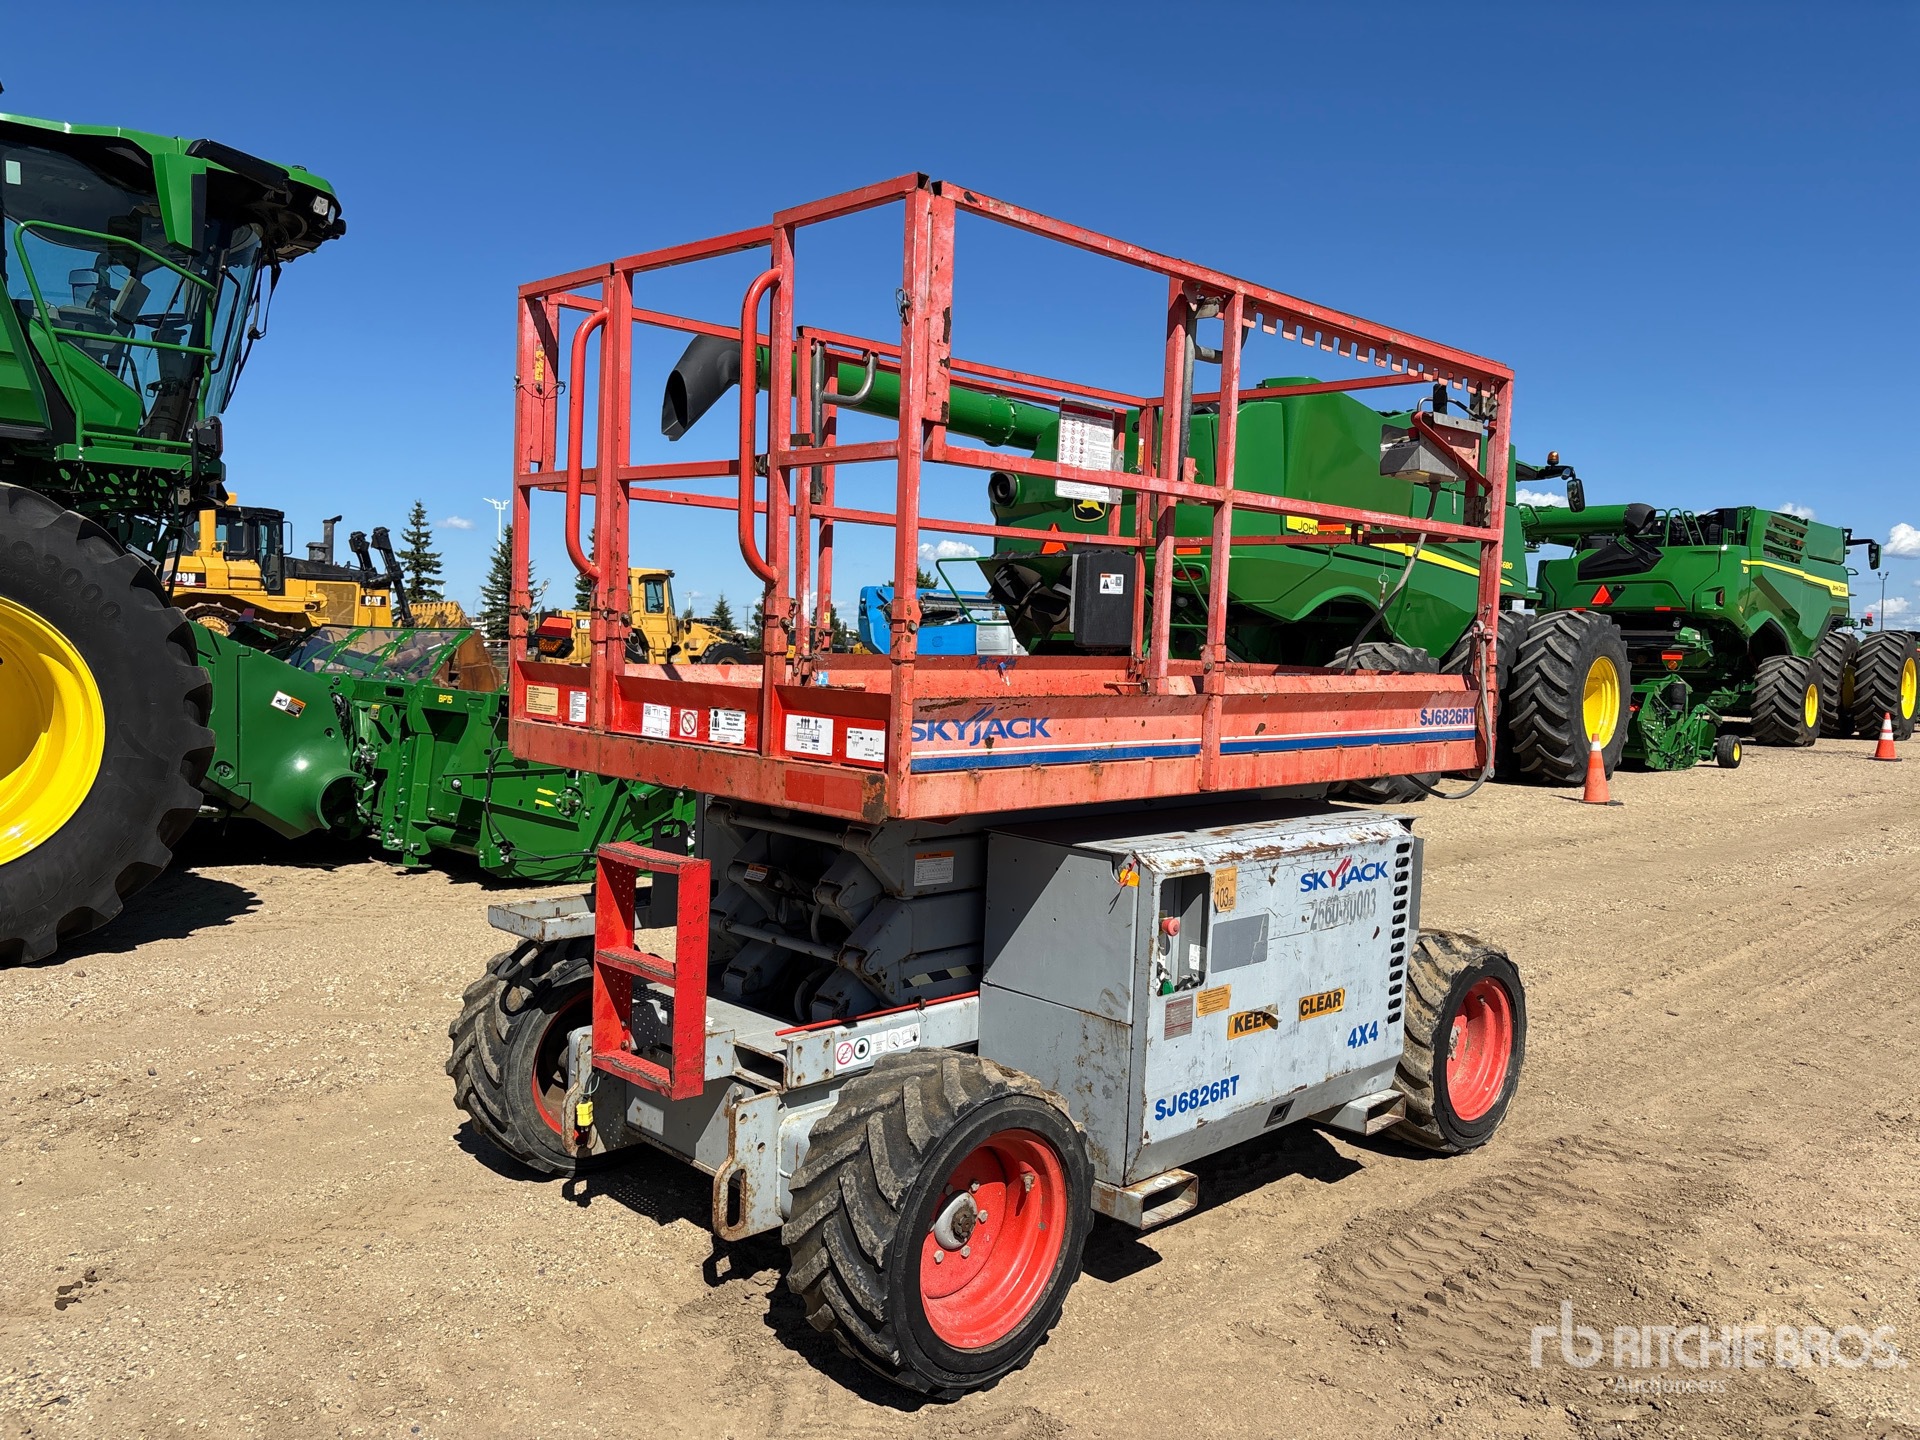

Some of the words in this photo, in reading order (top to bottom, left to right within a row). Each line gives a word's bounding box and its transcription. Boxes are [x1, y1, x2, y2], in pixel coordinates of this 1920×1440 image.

[365, 595, 382, 606] CAT
[911, 705, 1051, 746] SKYJACK
[1420, 708, 1475, 726] SJ6826RT
[1300, 857, 1389, 892] SKYJACK
[1216, 887, 1229, 908] 103
[1301, 991, 1342, 1016] CLEAR
[1347, 1020, 1379, 1049] 4X4
[1154, 1074, 1240, 1121] SJ6826RT
